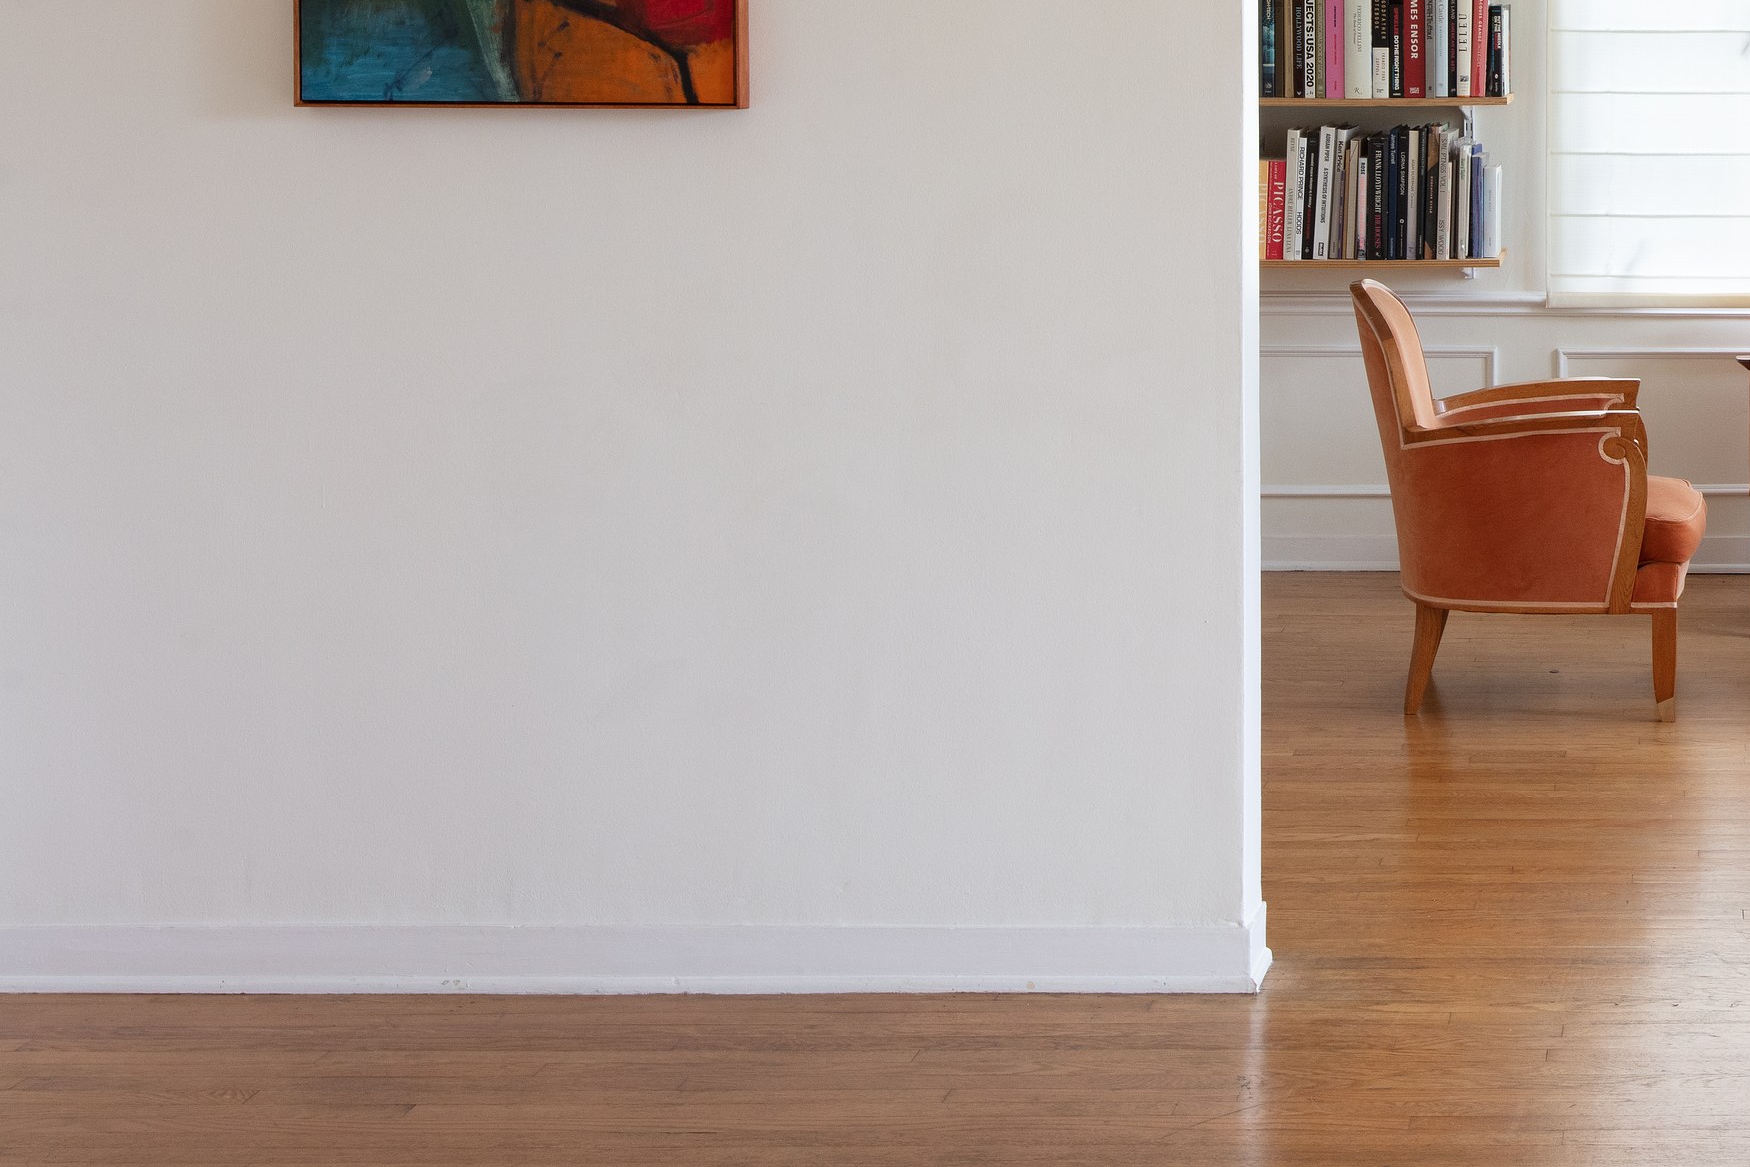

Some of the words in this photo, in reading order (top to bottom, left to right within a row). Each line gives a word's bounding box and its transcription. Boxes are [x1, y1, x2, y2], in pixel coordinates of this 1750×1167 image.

[1450, 0, 1455, 7] DE
[1393, 35, 1399, 44] DO
[1410, 23, 1418, 59] ENSOR
[1458, 13, 1467, 52] LELEU
[1306, 62, 1314, 87] 2020
[1272, 181, 1284, 243] PICASSO
